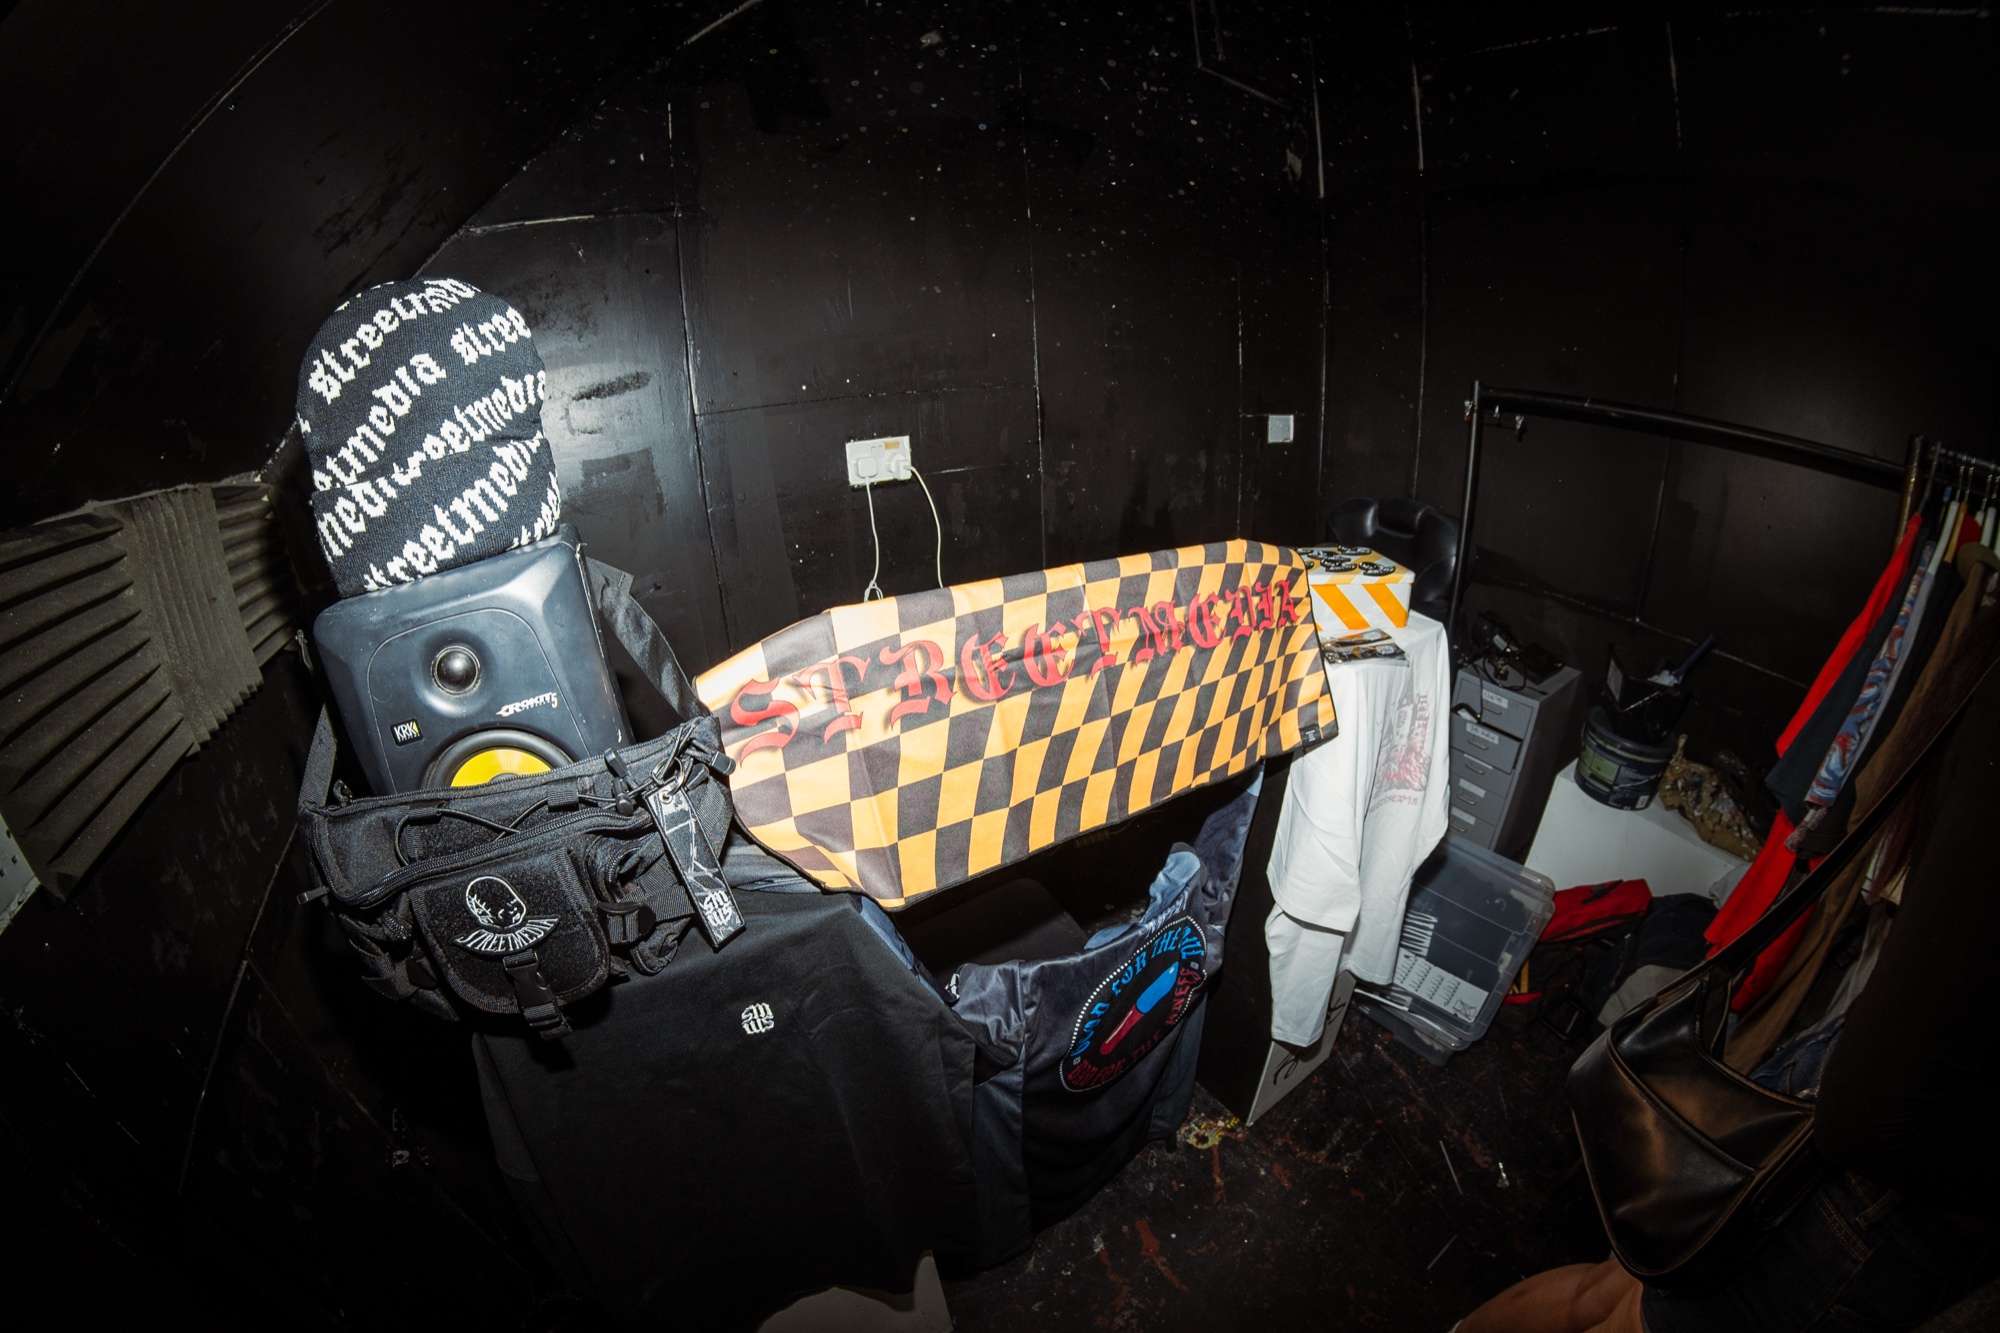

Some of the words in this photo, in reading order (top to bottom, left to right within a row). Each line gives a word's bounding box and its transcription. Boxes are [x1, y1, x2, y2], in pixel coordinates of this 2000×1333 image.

[730, 578, 1300, 766] STREETMEDIA
[394, 721, 417, 739] KRK
[454, 917, 560, 951] STREETMEDIA
[1111, 951, 1147, 995] FOR
